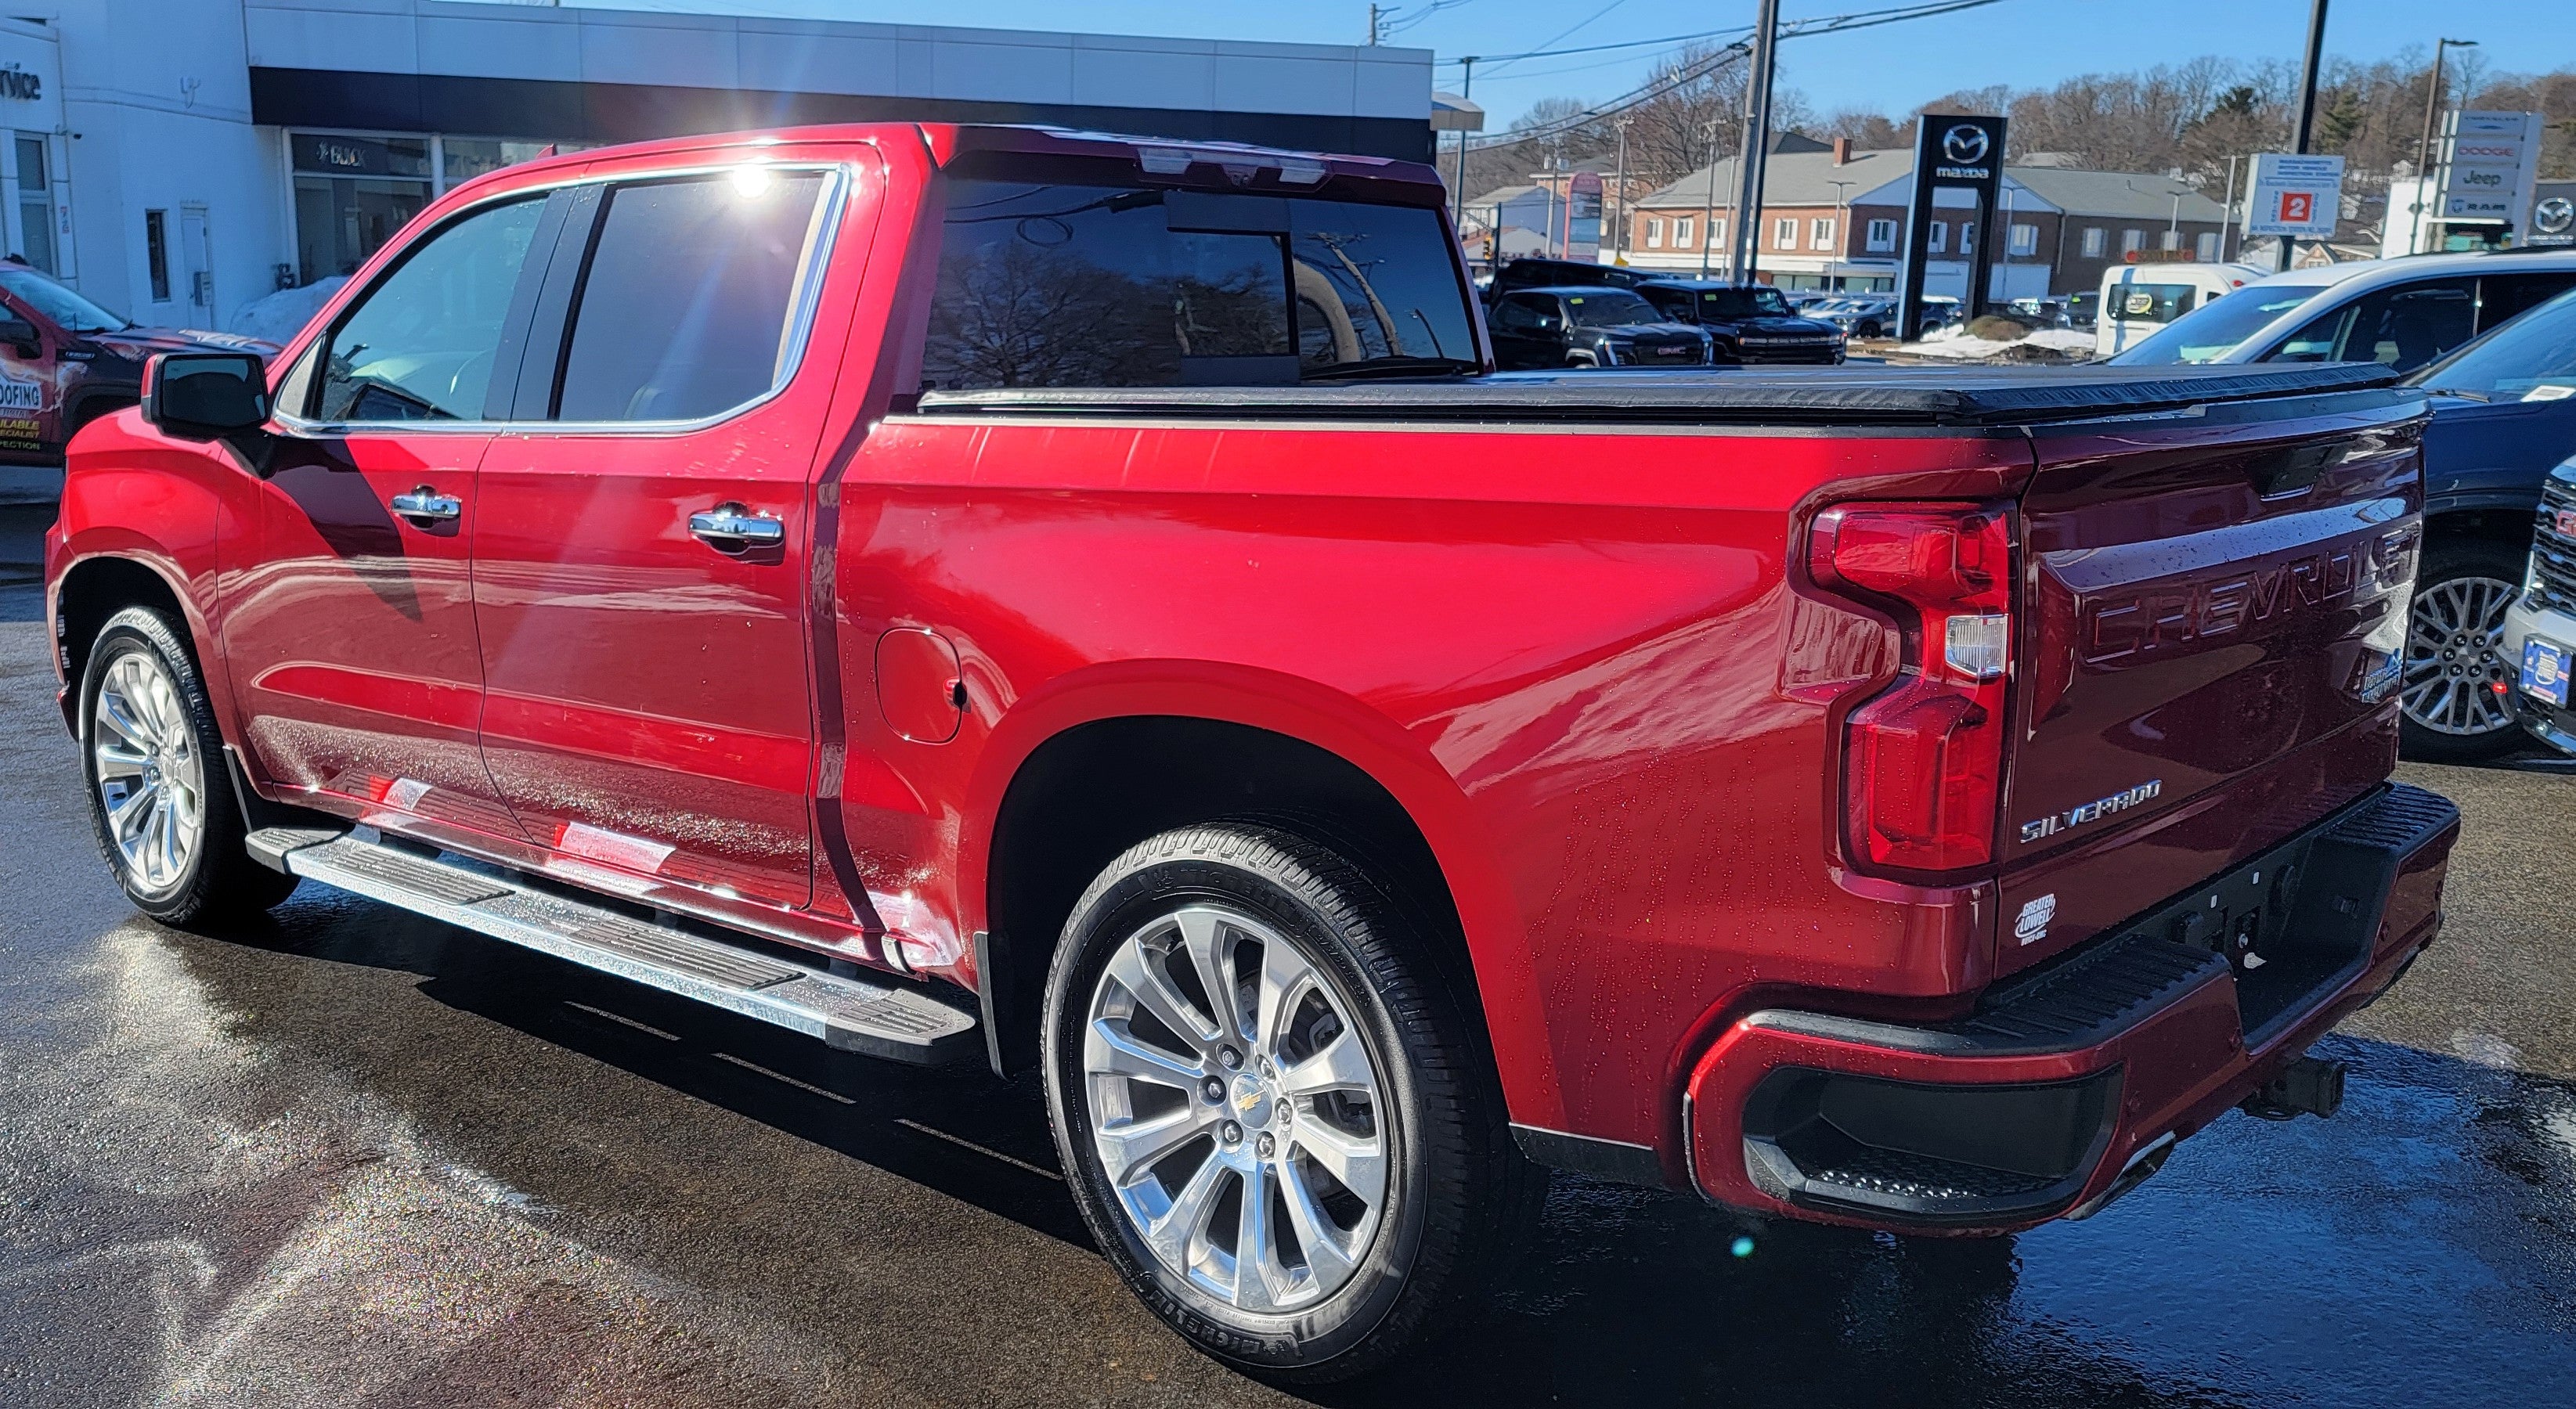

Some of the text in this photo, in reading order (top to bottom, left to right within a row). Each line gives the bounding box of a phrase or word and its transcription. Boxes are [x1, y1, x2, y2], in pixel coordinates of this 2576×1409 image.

[2458, 146, 2515, 157] DODGE
[1936, 167, 1989, 178] mazda
[2462, 170, 2502, 187] Jeep
[2288, 196, 2306, 218] 2
[2086, 524, 2419, 663] CHEVROLET
[2020, 778, 2163, 844] SILVERADO
[2022, 893, 2055, 917] GREATER
[2019, 908, 2051, 933] LOWELL
[1149, 1289, 1261, 1355] MICHELIN
